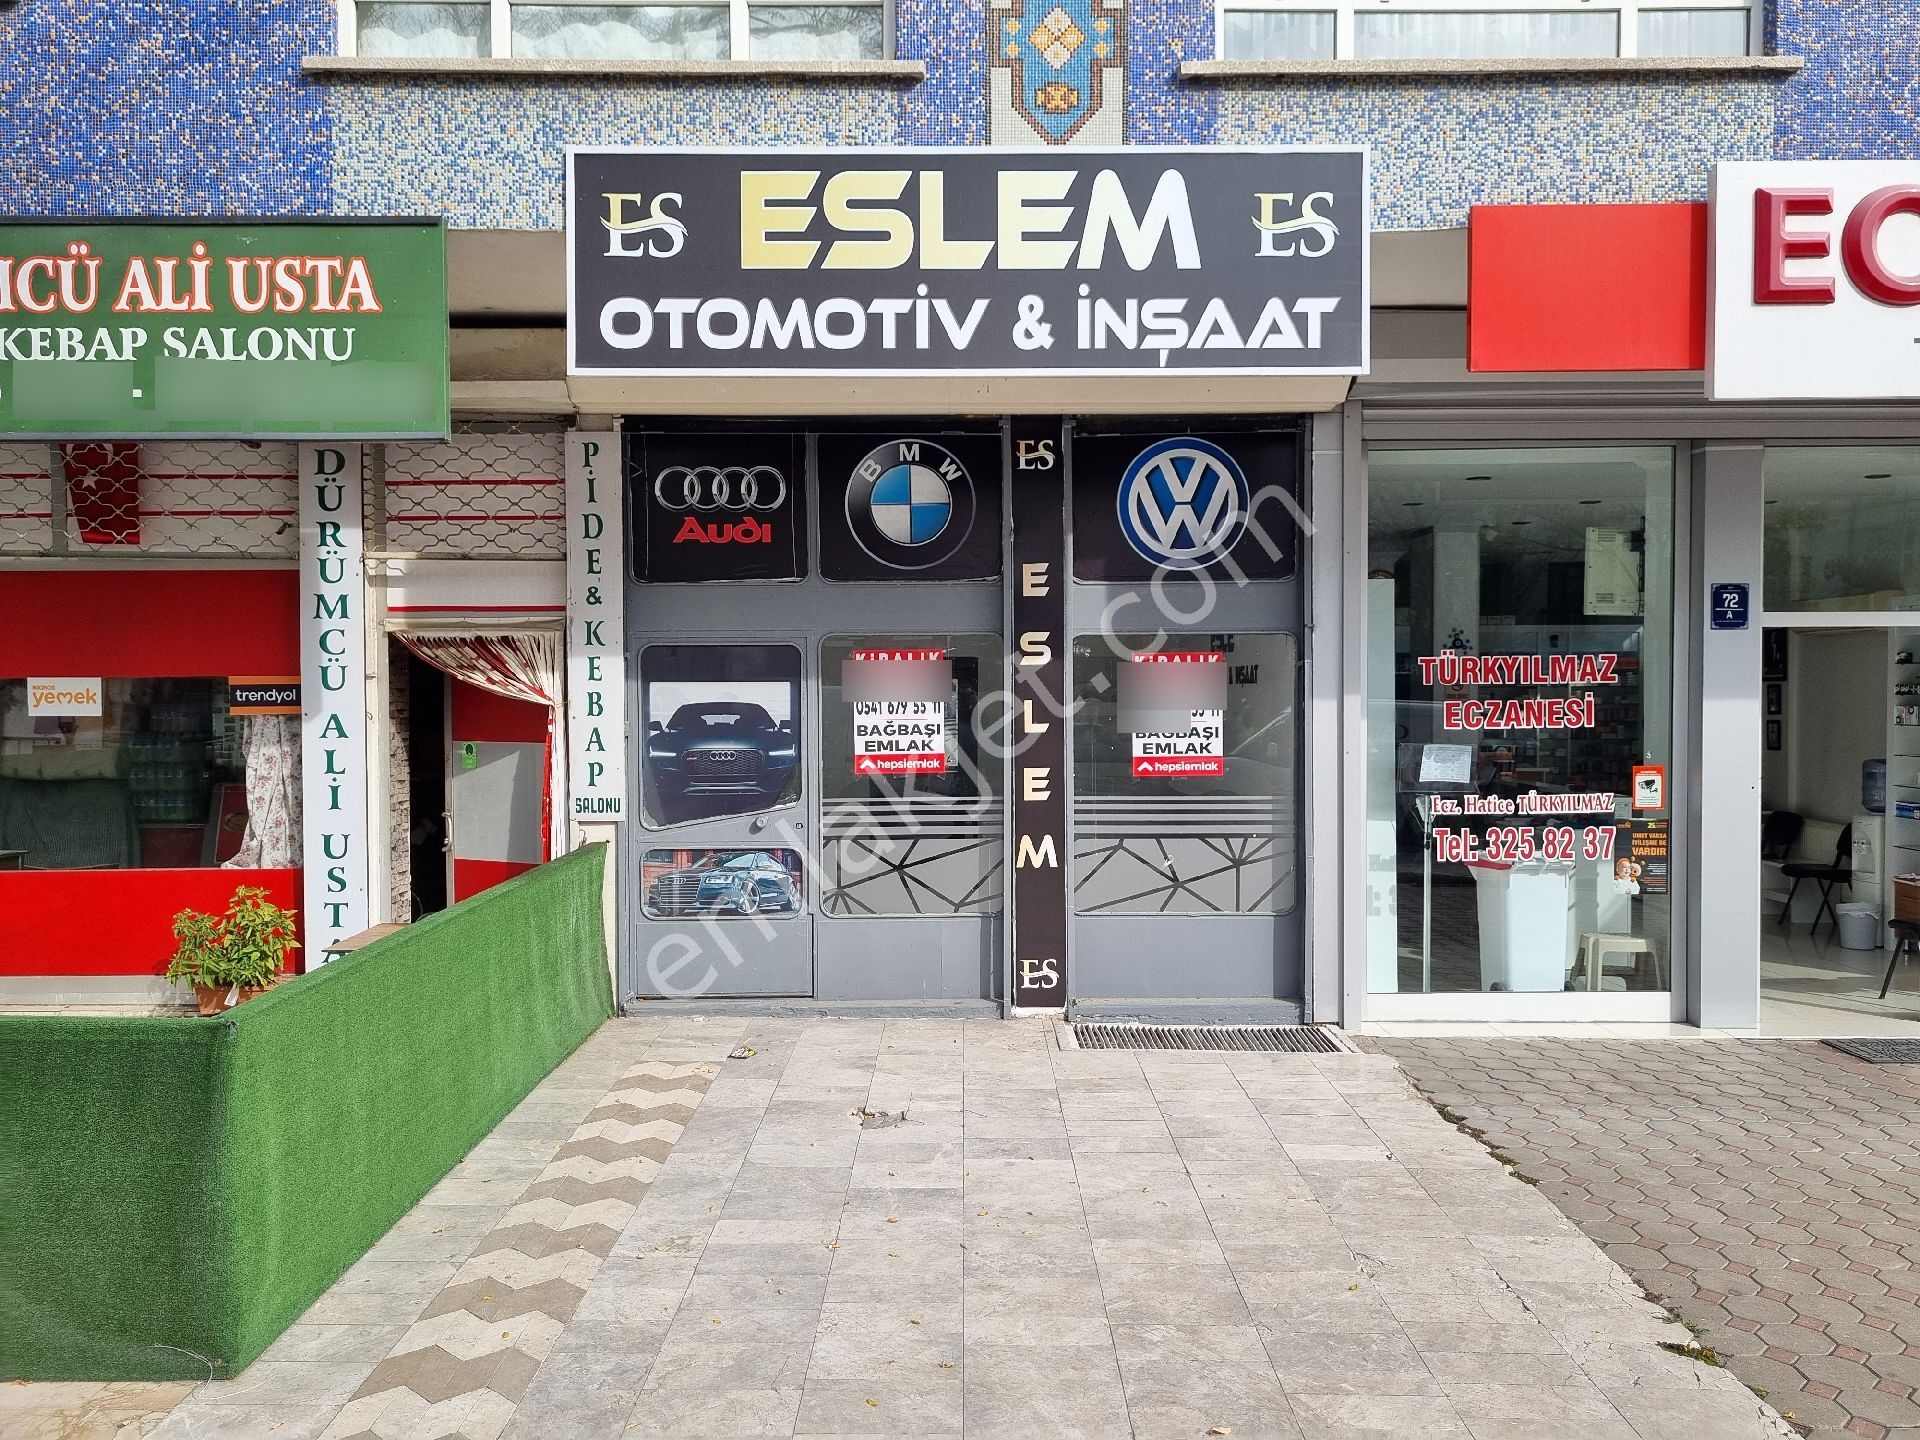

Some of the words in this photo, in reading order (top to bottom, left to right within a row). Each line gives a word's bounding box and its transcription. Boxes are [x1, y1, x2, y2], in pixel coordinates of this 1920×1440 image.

[600, 192, 688, 258] ES
[741, 169, 1201, 271] ESLEM
[1251, 191, 1340, 257] ES
[112, 241, 214, 312] ALİ
[226, 256, 382, 313] USTA
[600, 283, 992, 349] OTOMOTİV
[1012, 294, 1056, 349] &
[1077, 283, 1343, 368] İNŞAAT
[0, 327, 147, 361] KEBAP
[163, 327, 356, 361] SALONU
[859, 443, 963, 484] BMW
[1016, 440, 1056, 470] ES
[581, 442, 604, 574] PİDE
[673, 516, 773, 543] Audi
[313, 448, 351, 692] DÜRÜMCÜ
[1722, 593, 1739, 608] 72
[1726, 610, 1734, 620] A
[1418, 649, 1618, 685] TÜRKYILMAZ
[33, 688, 97, 709] yemek
[235, 688, 297, 704] trendyol
[584, 620, 607, 788] KEBAP
[1444, 692, 1595, 730] ECZANESİ
[856, 720, 941, 738] BAĞBAŞI
[1016, 562, 1059, 868] ESLEM
[318, 713, 350, 811] ALİ
[864, 740, 935, 752] EMLAK
[1142, 743, 1213, 754] EMLAK
[877, 758, 941, 771] hepsiemlak
[1154, 760, 1219, 773] hepsiemlak
[575, 797, 621, 814] SALONU
[1430, 795, 1463, 815] Ecz.
[1464, 793, 1515, 815] Hatice
[1516, 790, 1616, 814] TÜRKYILMAZ
[1433, 827, 1479, 862] Tel:
[1486, 827, 1535, 862] 325
[1542, 827, 1576, 861] 82
[1582, 826, 1617, 860] 37
[1631, 846, 1667, 855] VARDIR
[1020, 958, 1060, 989] ES
